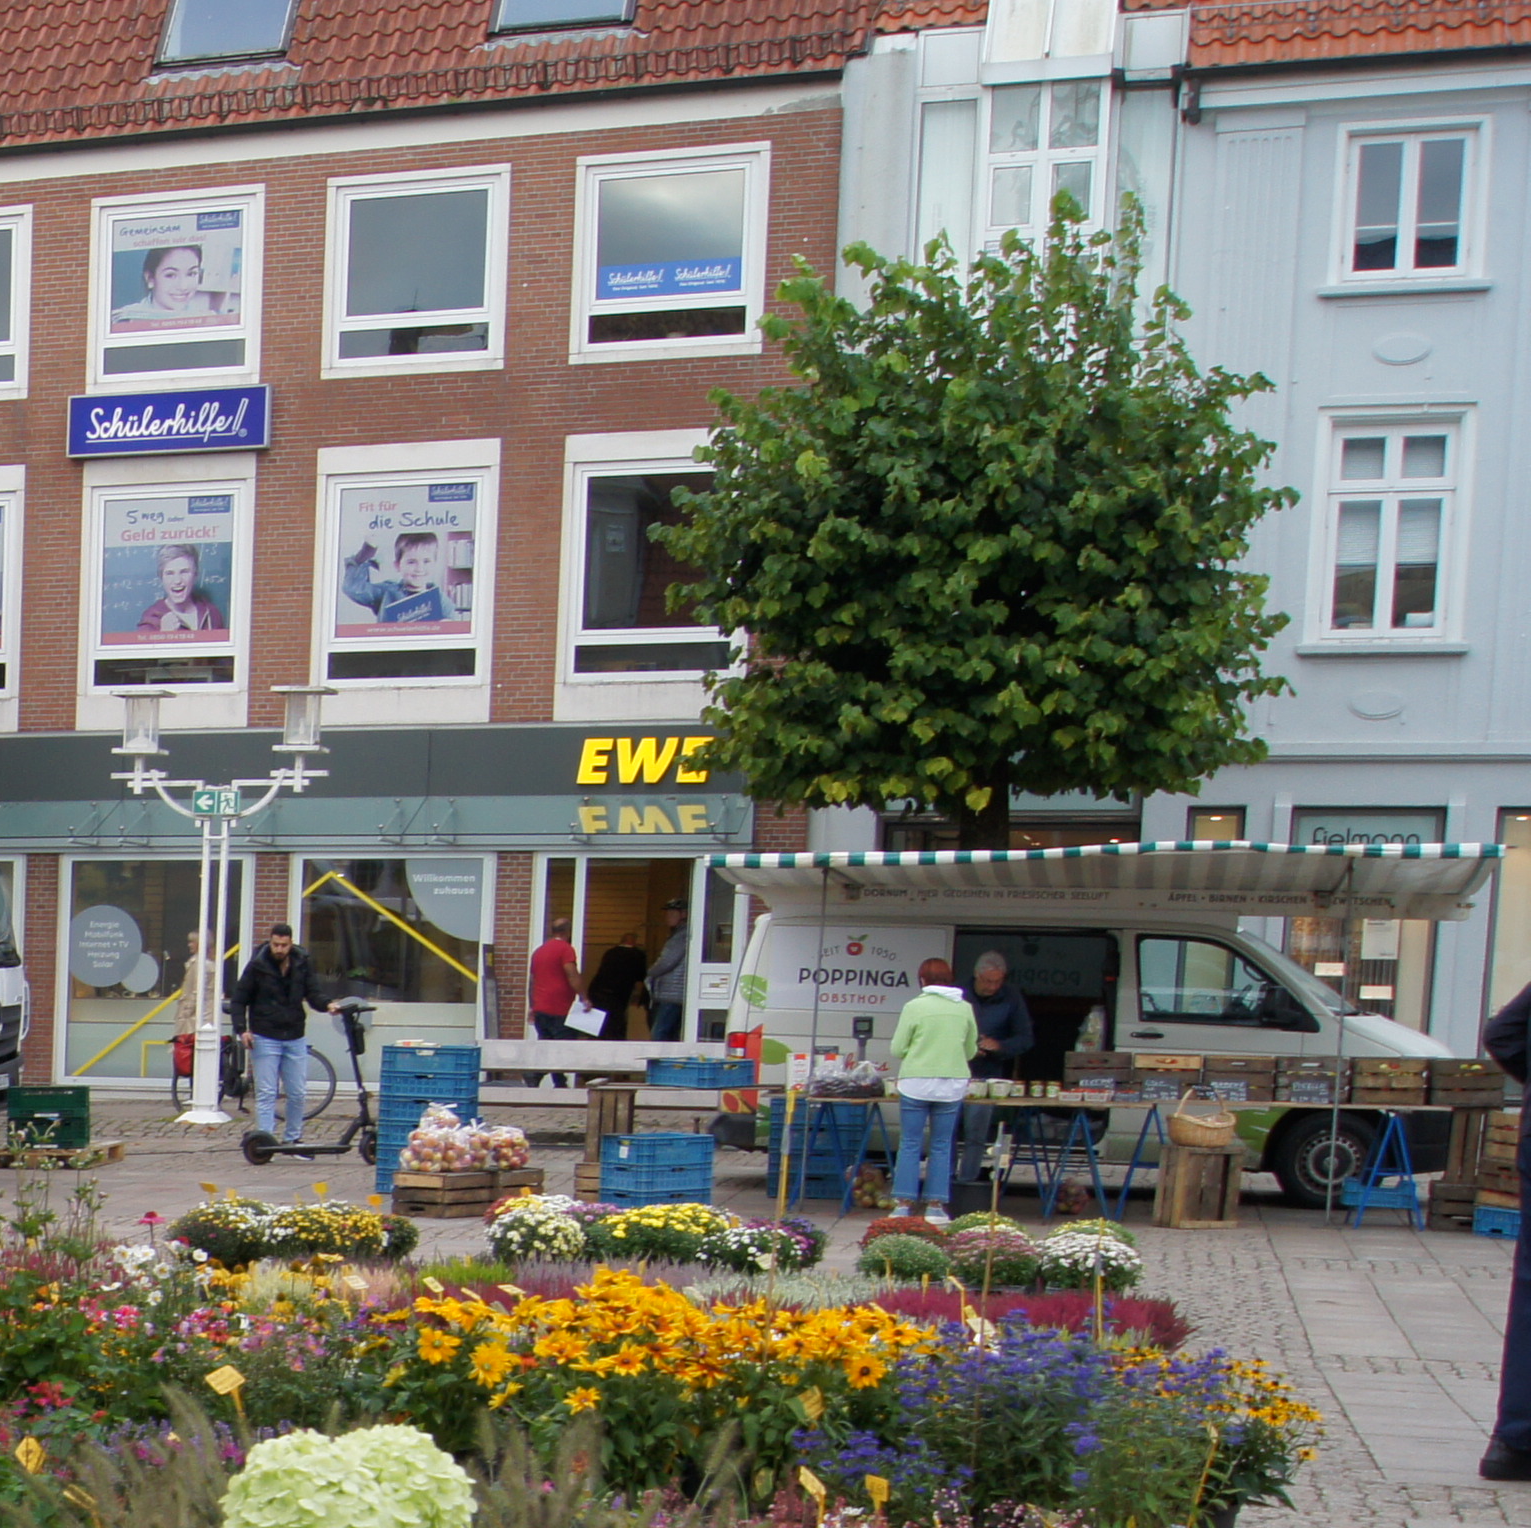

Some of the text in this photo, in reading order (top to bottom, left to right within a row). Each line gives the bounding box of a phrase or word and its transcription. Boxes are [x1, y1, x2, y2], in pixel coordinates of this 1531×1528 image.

[119, 224, 181, 237] Gemeinsam
[674, 264, 732, 281] Schülerhilfe!
[86, 398, 249, 443] Schülerhilfe!
[358, 501, 397, 512] Fit für
[126, 509, 139, 524] 5
[141, 511, 165, 524] weg
[369, 510, 459, 530] die Schule
[121, 527, 156, 541] Geld
[576, 737, 715, 784] EWE
[412, 873, 476, 883] Willkommen
[433, 886, 476, 895] zuhause
[863, 887, 1110, 901] DORNUM HIER GEDEIHEN IN FRIESISCHER SEELUFT
[1168, 891, 1197, 902] ÄPFEL
[1209, 893, 1247, 903] BIRNEN
[1258, 894, 1307, 904] KIRSCHEN
[89, 920, 121, 930] Energie
[870, 945, 897, 962] 1950
[798, 967, 910, 988] POPPINGA
[819, 992, 887, 1006] OBSTHOF
